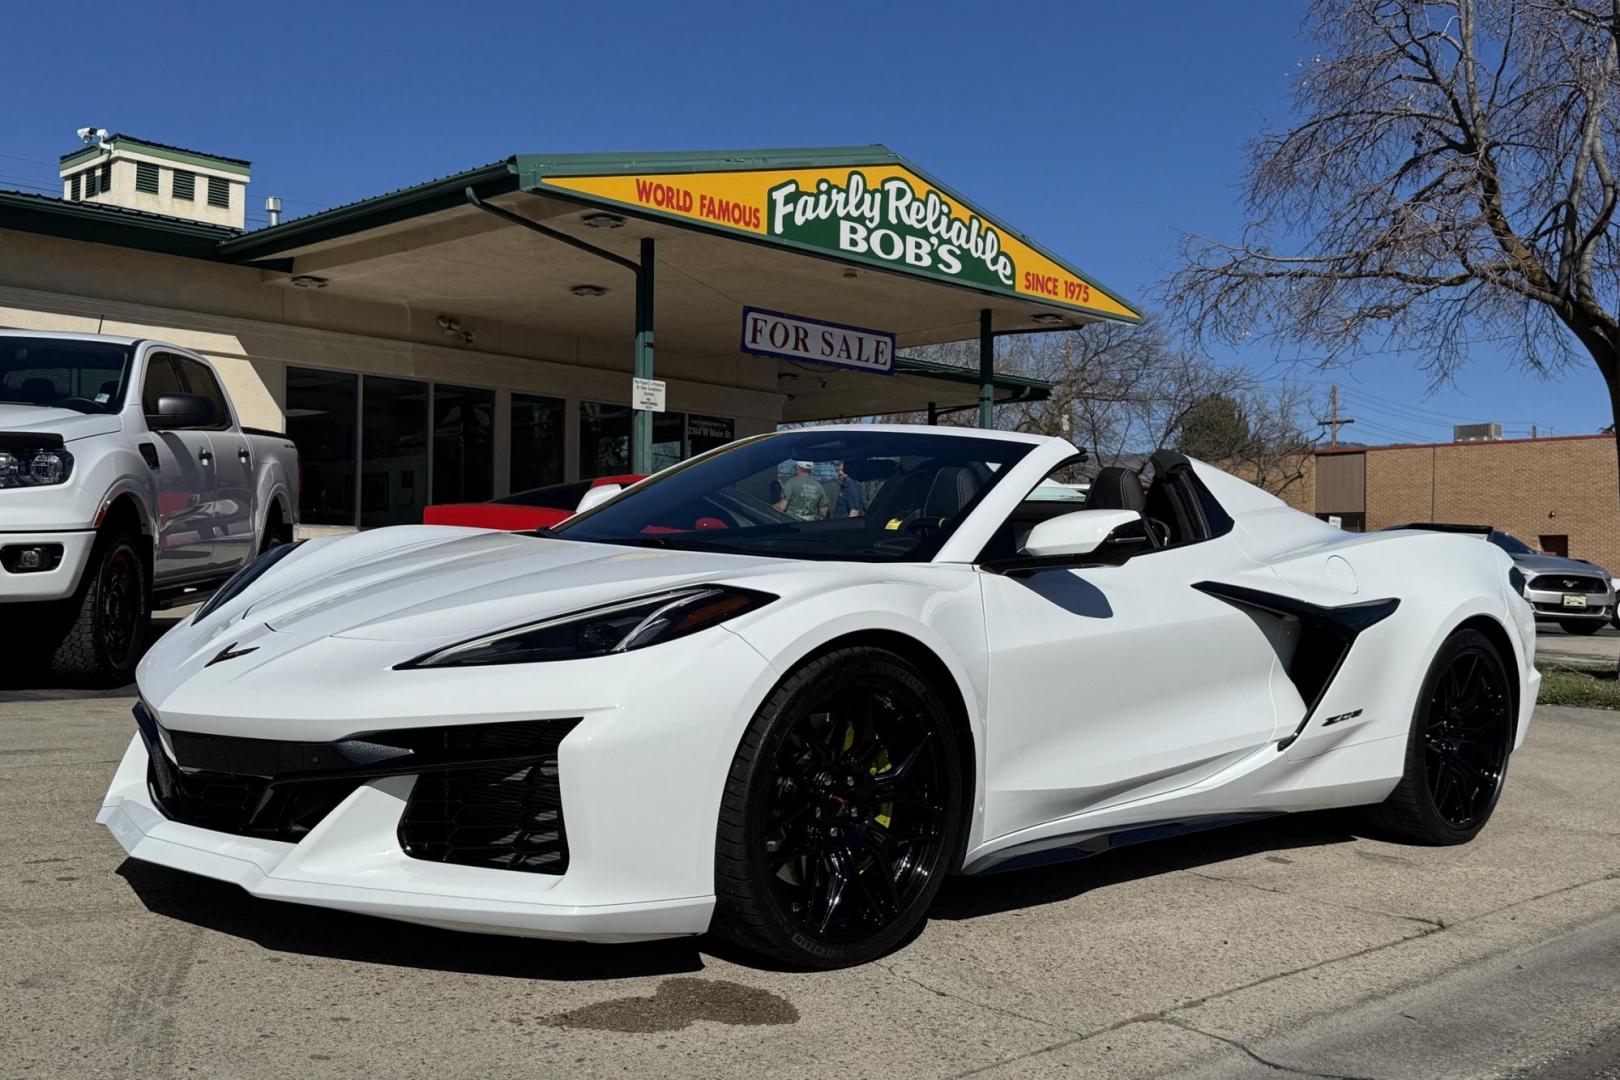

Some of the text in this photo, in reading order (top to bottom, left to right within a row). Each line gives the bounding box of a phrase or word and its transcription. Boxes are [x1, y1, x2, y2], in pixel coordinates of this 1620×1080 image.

[635, 178, 760, 229] WORLD FAMOUS
[772, 174, 1013, 284] Fairly Reliable
[839, 219, 962, 274] BOB'S
[1024, 271, 1089, 303] SINCE 1975
[750, 317, 888, 366] FOR SALE
